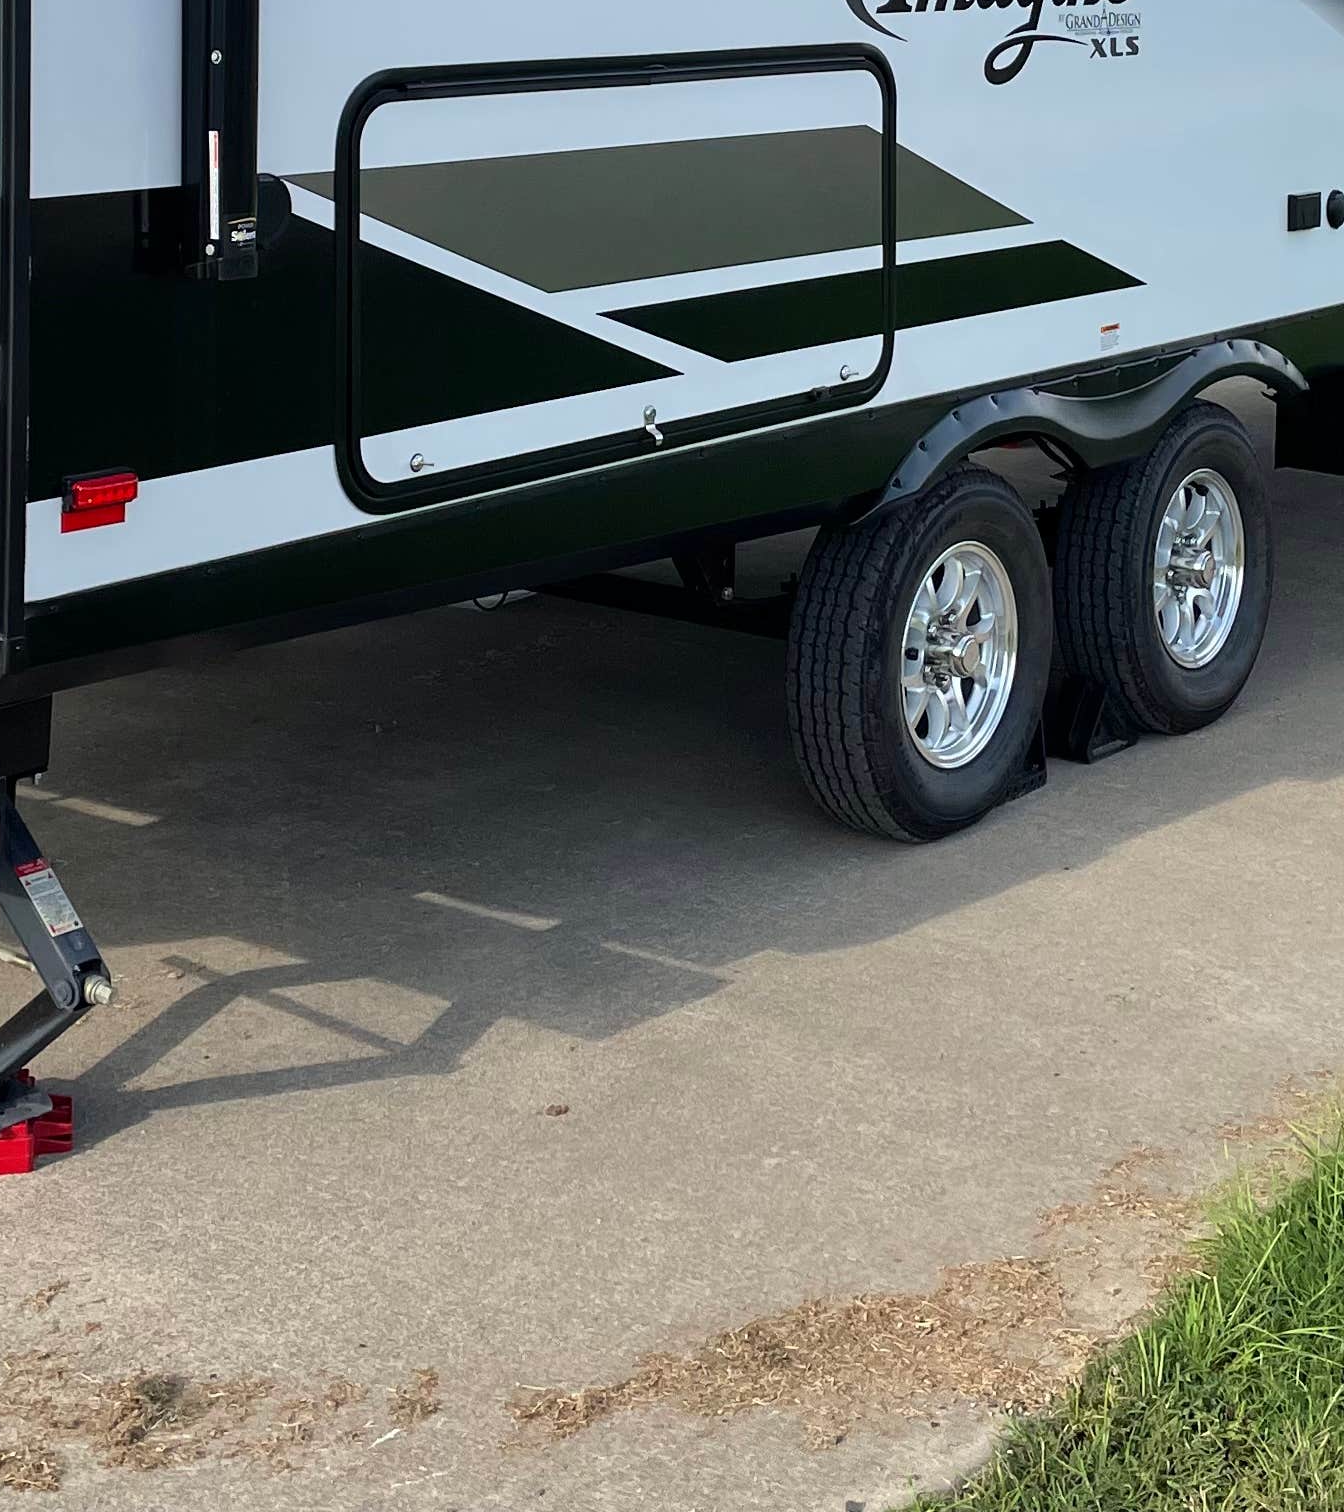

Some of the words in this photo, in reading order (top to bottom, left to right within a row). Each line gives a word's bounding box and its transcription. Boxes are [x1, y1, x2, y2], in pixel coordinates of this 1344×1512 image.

[1065, 13, 1101, 29] GRAND
[1109, 11, 1140, 27] DESIGN
[1090, 36, 1139, 58] XLS
